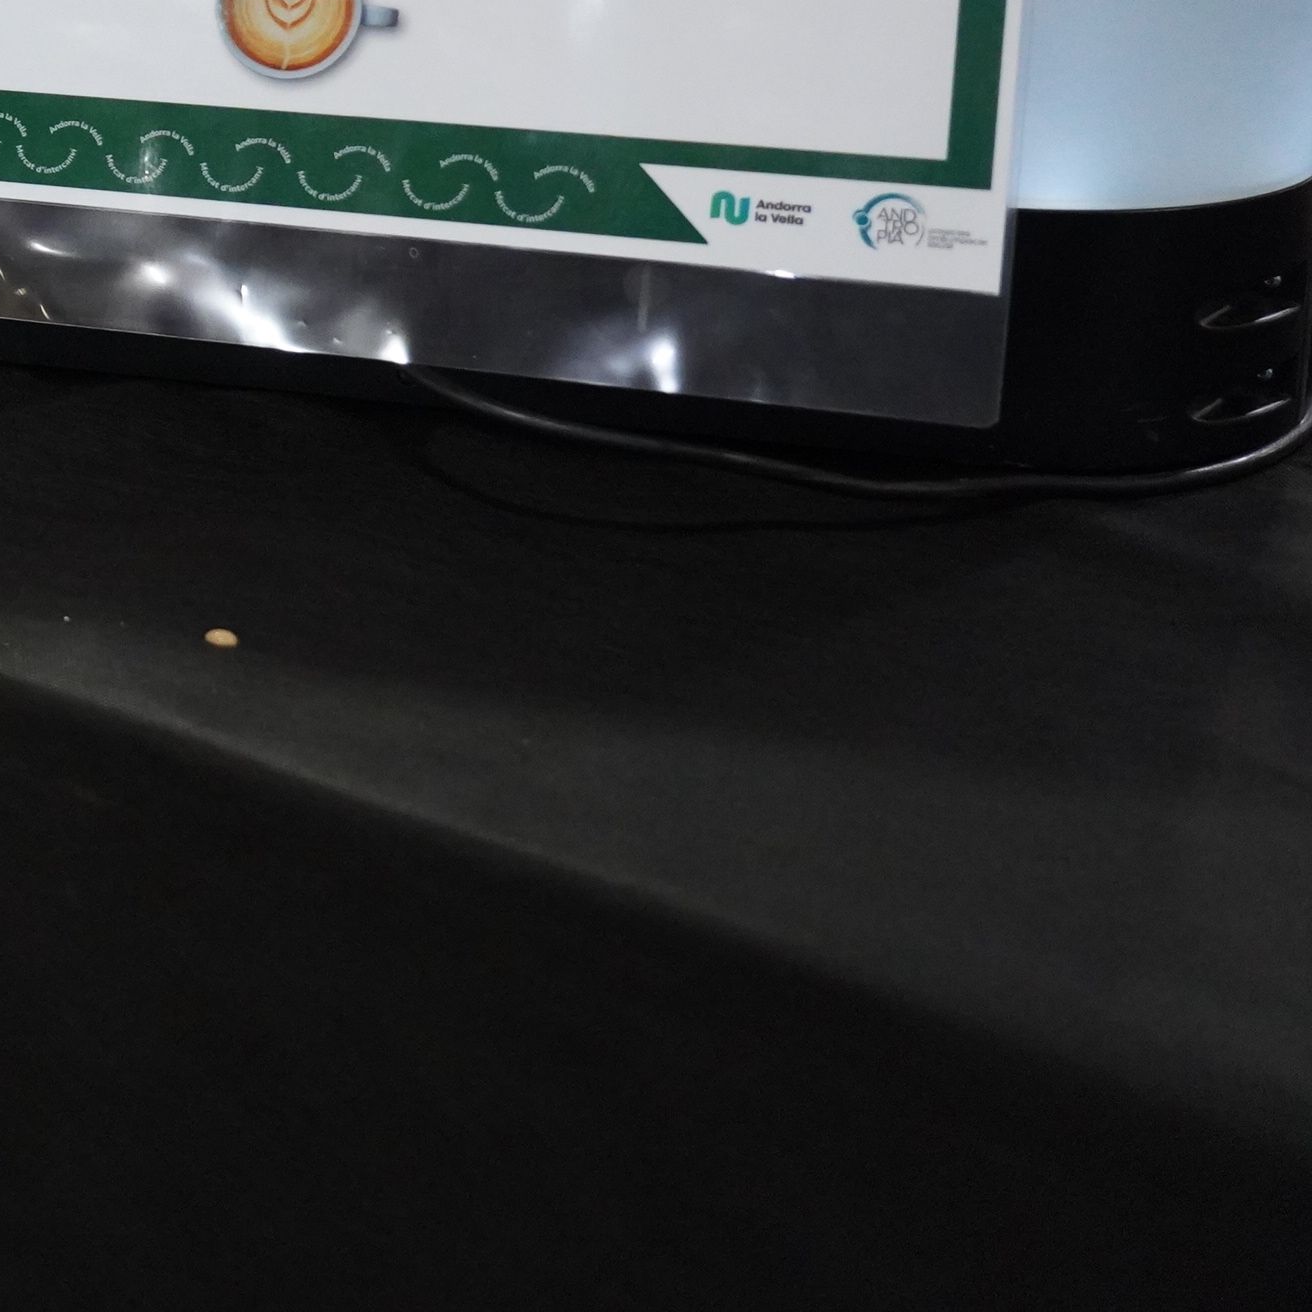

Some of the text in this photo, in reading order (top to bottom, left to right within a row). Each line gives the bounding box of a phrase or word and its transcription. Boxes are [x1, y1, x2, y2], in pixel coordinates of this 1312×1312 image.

[5, 112, 14, 122] la
[14, 116, 28, 138] Vella
[48, 119, 104, 147] Andorra la Vella
[139, 128, 195, 157] Andorra la Vella
[234, 137, 292, 164] Andorra la Vella
[15, 144, 36, 171] Mercat
[105, 153, 126, 181] Mercat
[333, 144, 392, 173] Andorra la Vella
[439, 153, 499, 182] Andorra la Vella
[199, 162, 220, 190] Mercat
[296, 170, 318, 199] Mercat
[533, 164, 596, 194] Andorra la Vella
[401, 178, 423, 207] Mercat
[494, 190, 517, 219] Mercat
[755, 198, 812, 214] Andorra
[754, 211, 804, 226] la Vella
[876, 207, 917, 222] AND
